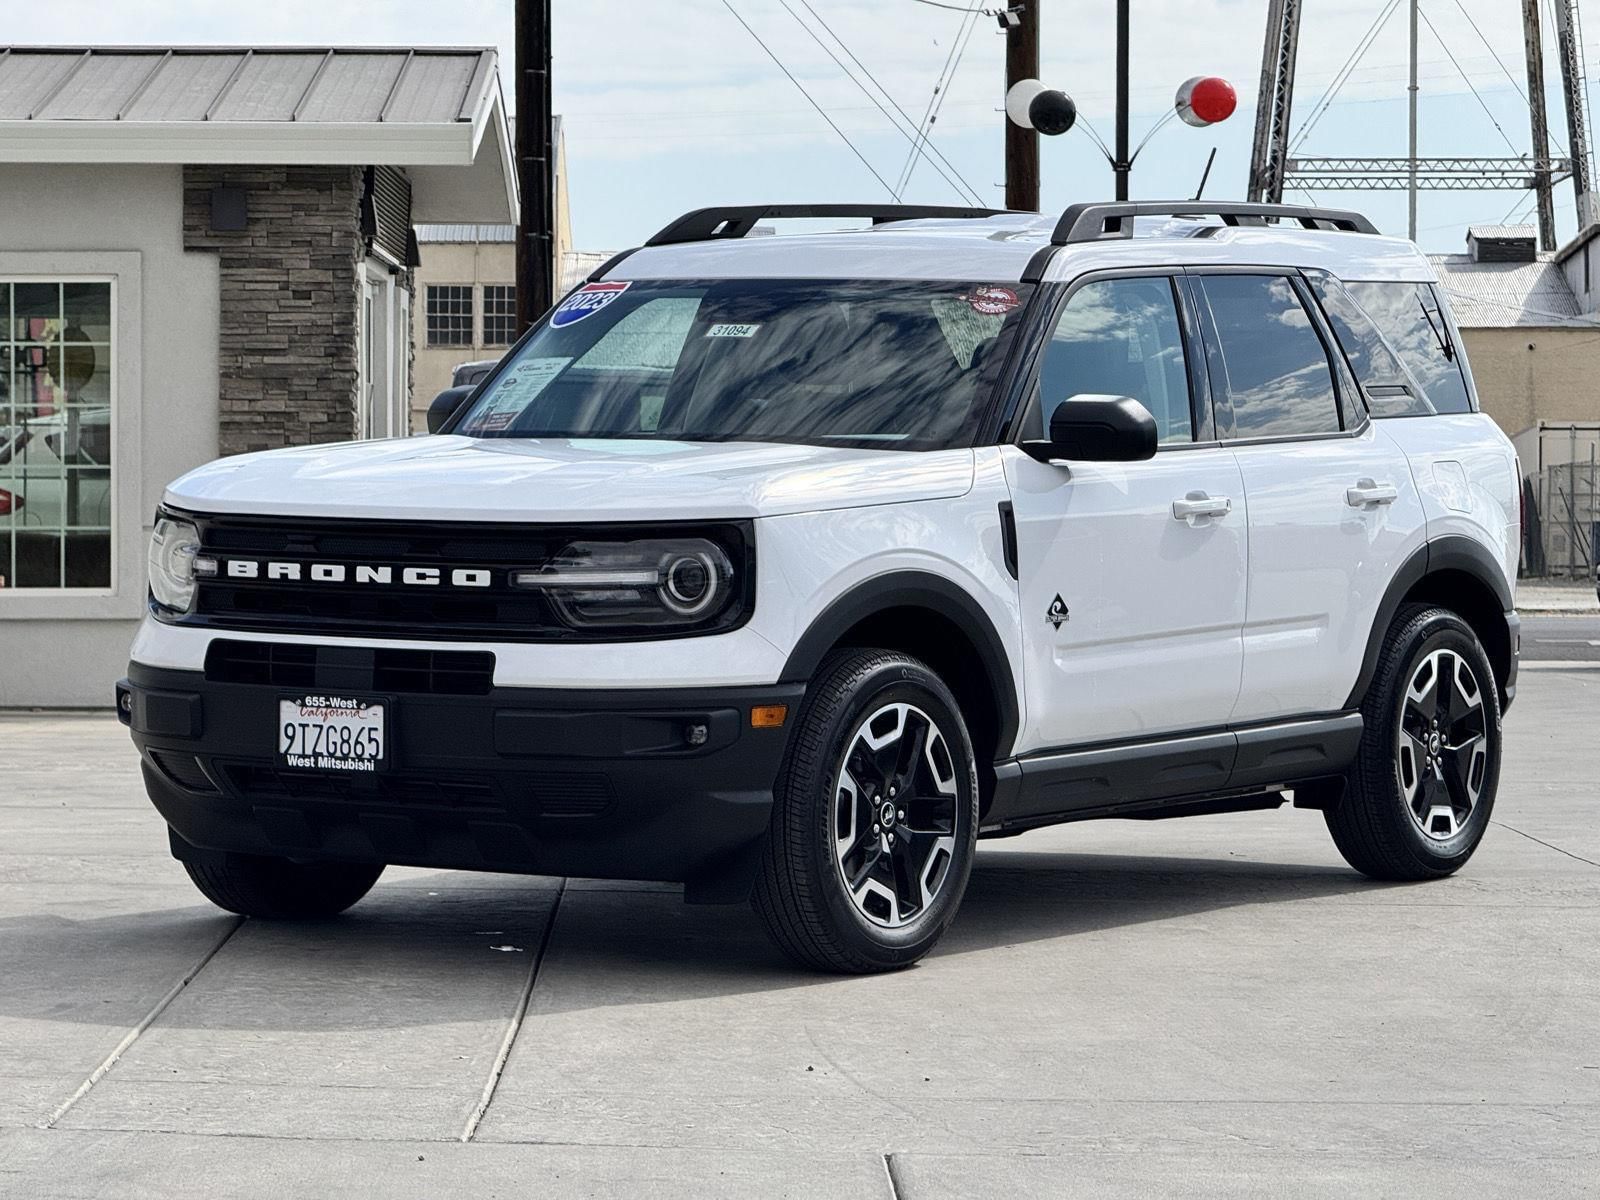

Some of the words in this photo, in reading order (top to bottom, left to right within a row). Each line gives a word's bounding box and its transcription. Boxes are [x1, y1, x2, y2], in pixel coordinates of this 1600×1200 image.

[559, 292, 615, 311] 2023
[713, 325, 751, 336] 31094
[227, 560, 491, 587] BRONCO
[305, 696, 358, 709] 655-West
[299, 706, 367, 722] California
[283, 722, 380, 758] 9TZG865
[286, 754, 315, 768] West
[317, 756, 375, 771] Mitsubishi
